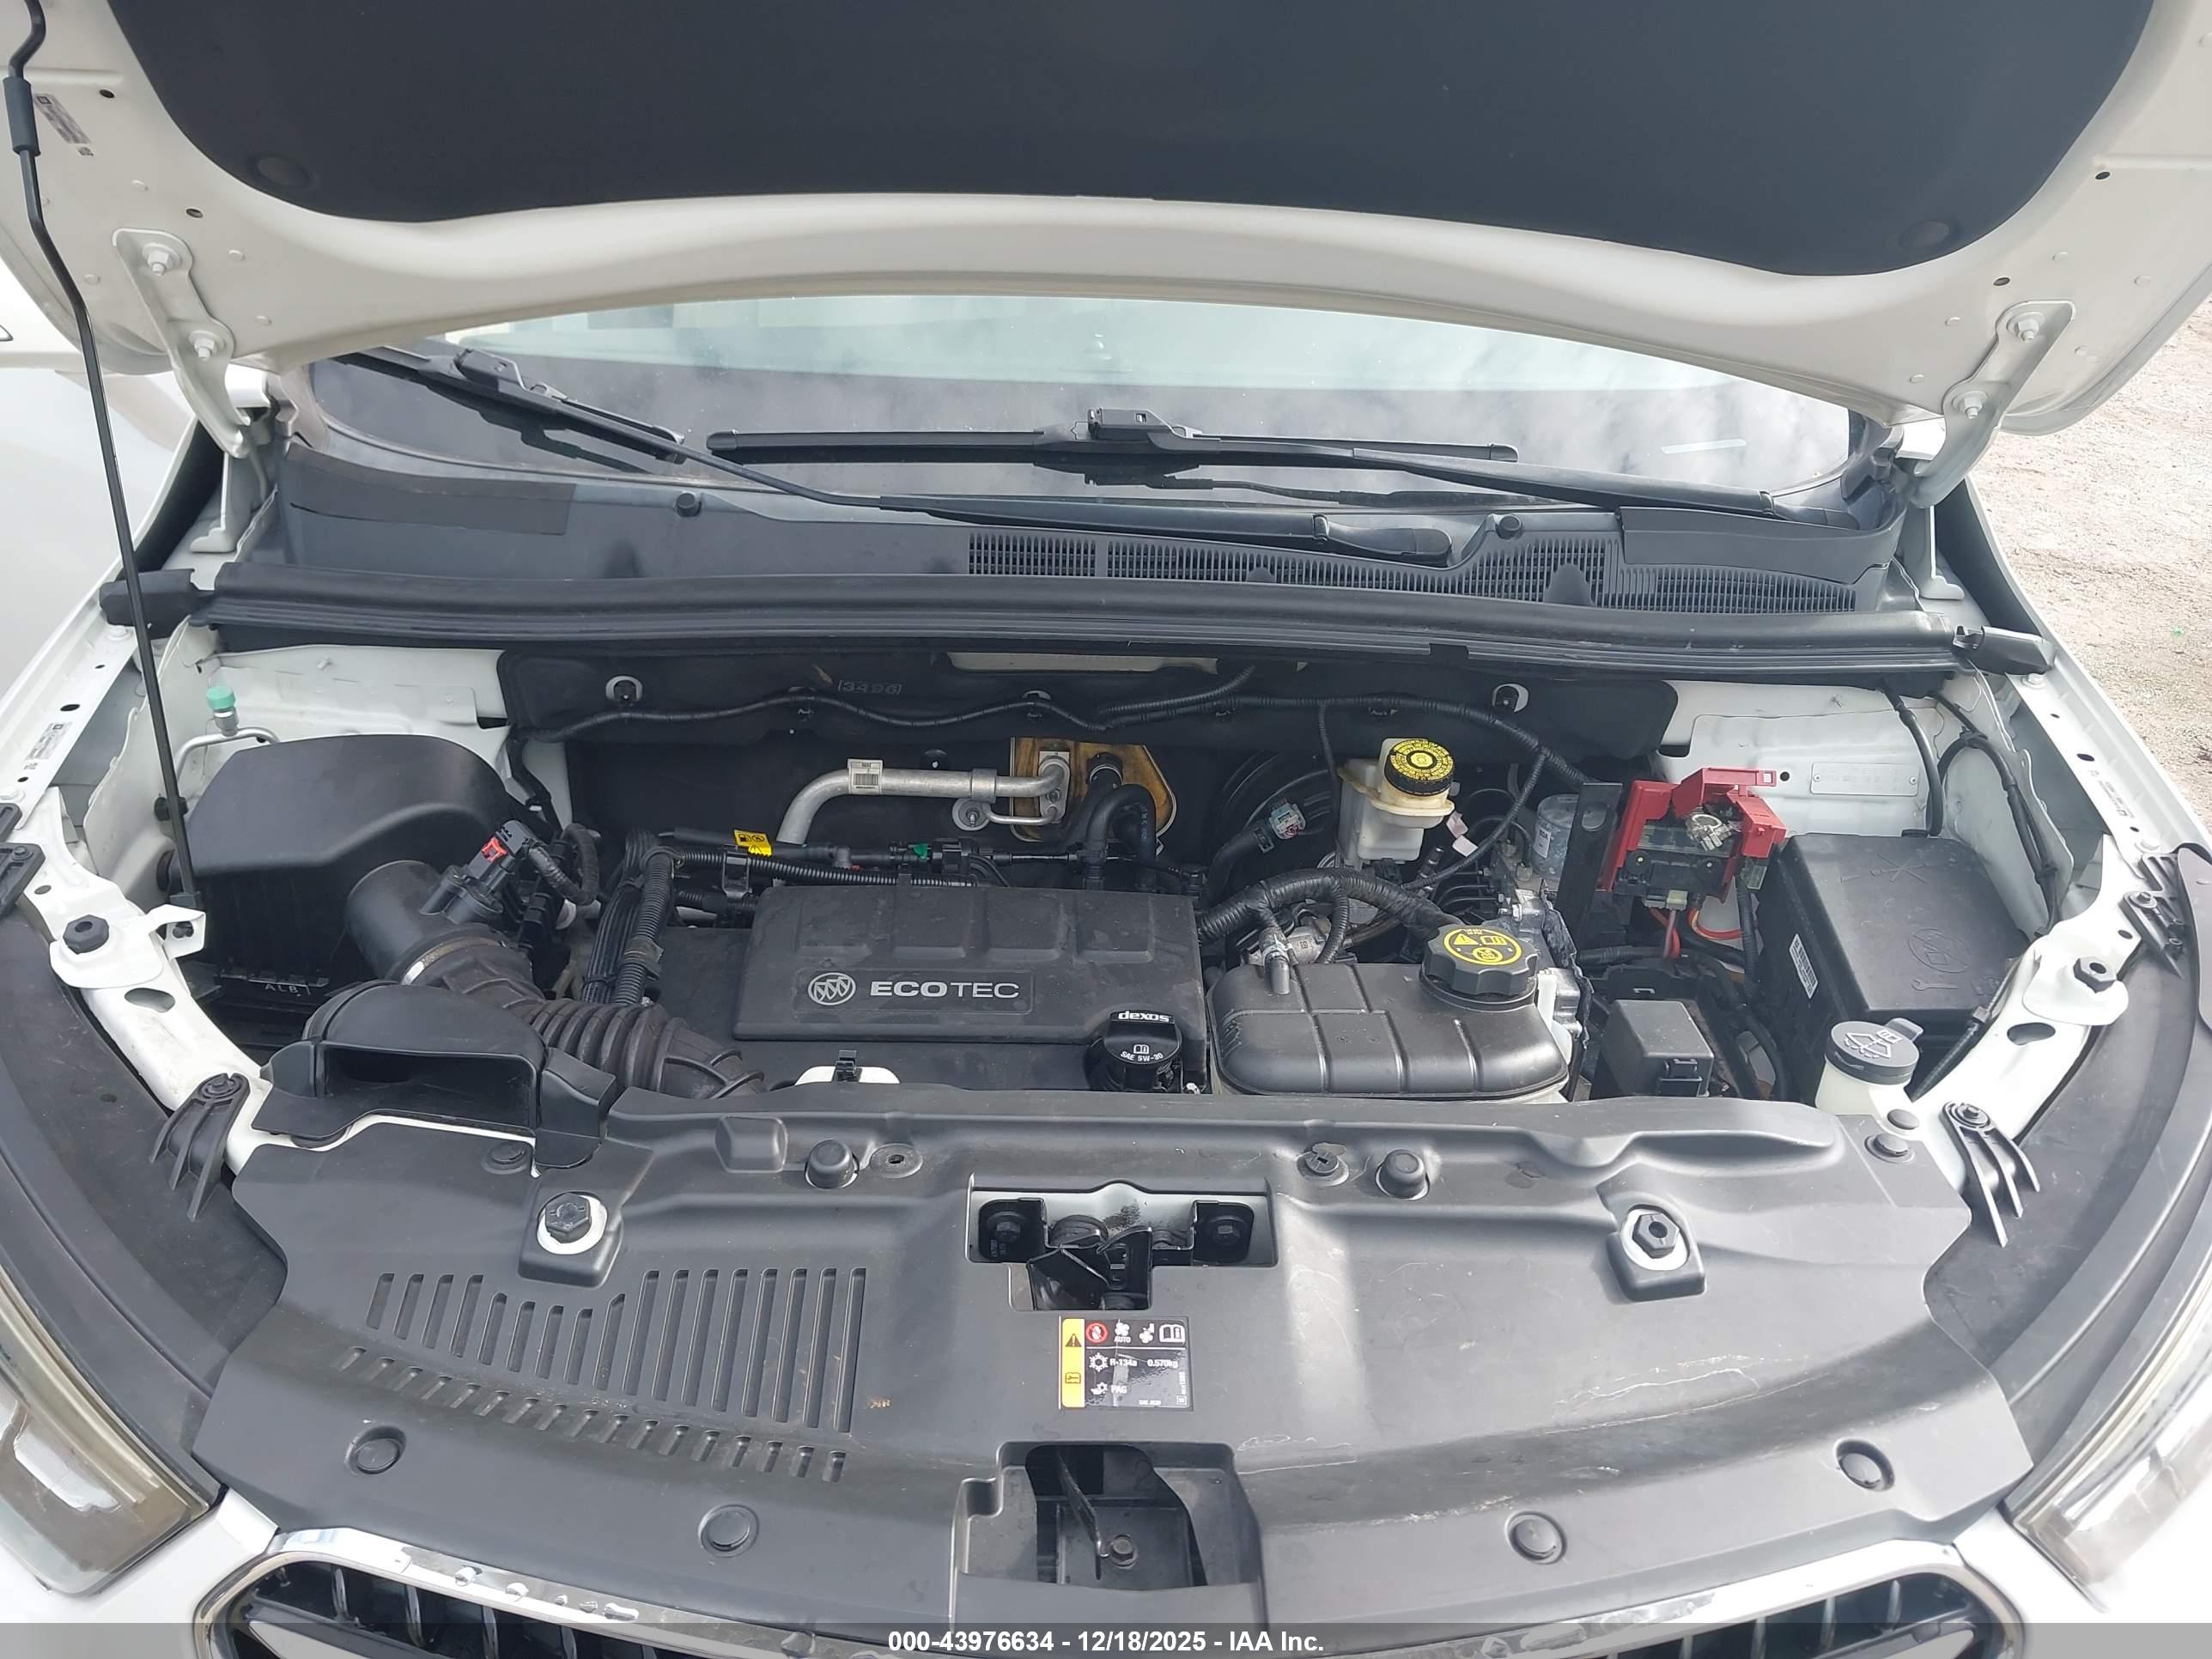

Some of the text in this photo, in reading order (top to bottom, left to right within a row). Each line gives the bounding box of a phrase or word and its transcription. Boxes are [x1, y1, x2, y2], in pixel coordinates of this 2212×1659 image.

[870, 981, 1019, 999] ECOTEC
[1118, 1011, 1172, 1022] dexos
[1120, 1051, 1164, 1061] SAE 5W-30
[1109, 1358, 1179, 1369] R-134a 0.570kg
[1110, 1385, 1127, 1395] PAG
